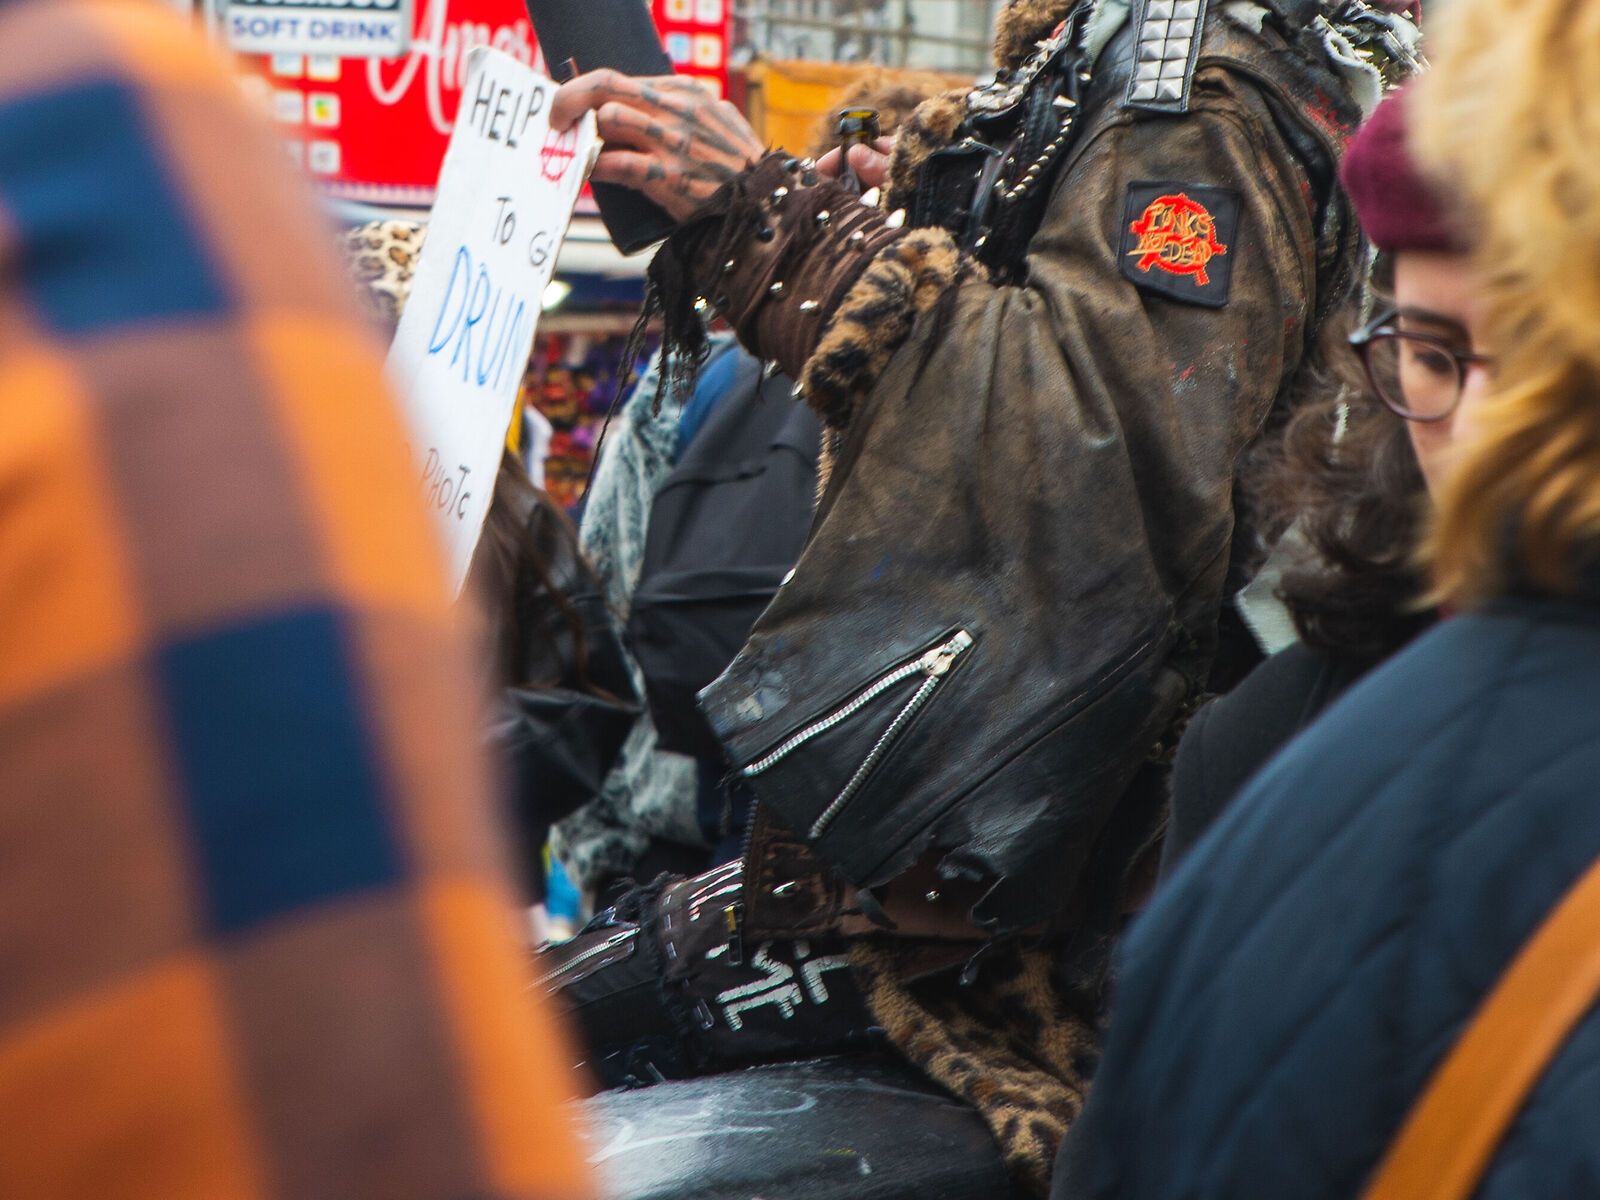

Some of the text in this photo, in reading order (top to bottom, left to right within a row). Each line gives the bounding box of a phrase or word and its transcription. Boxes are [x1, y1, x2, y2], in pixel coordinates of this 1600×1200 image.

[233, 17, 395, 41] SOFT DRINK
[469, 71, 546, 149] HELP
[492, 196, 517, 246] TO
[1147, 202, 1216, 241] PUNKS
[1160, 240, 1213, 264] DEAD
